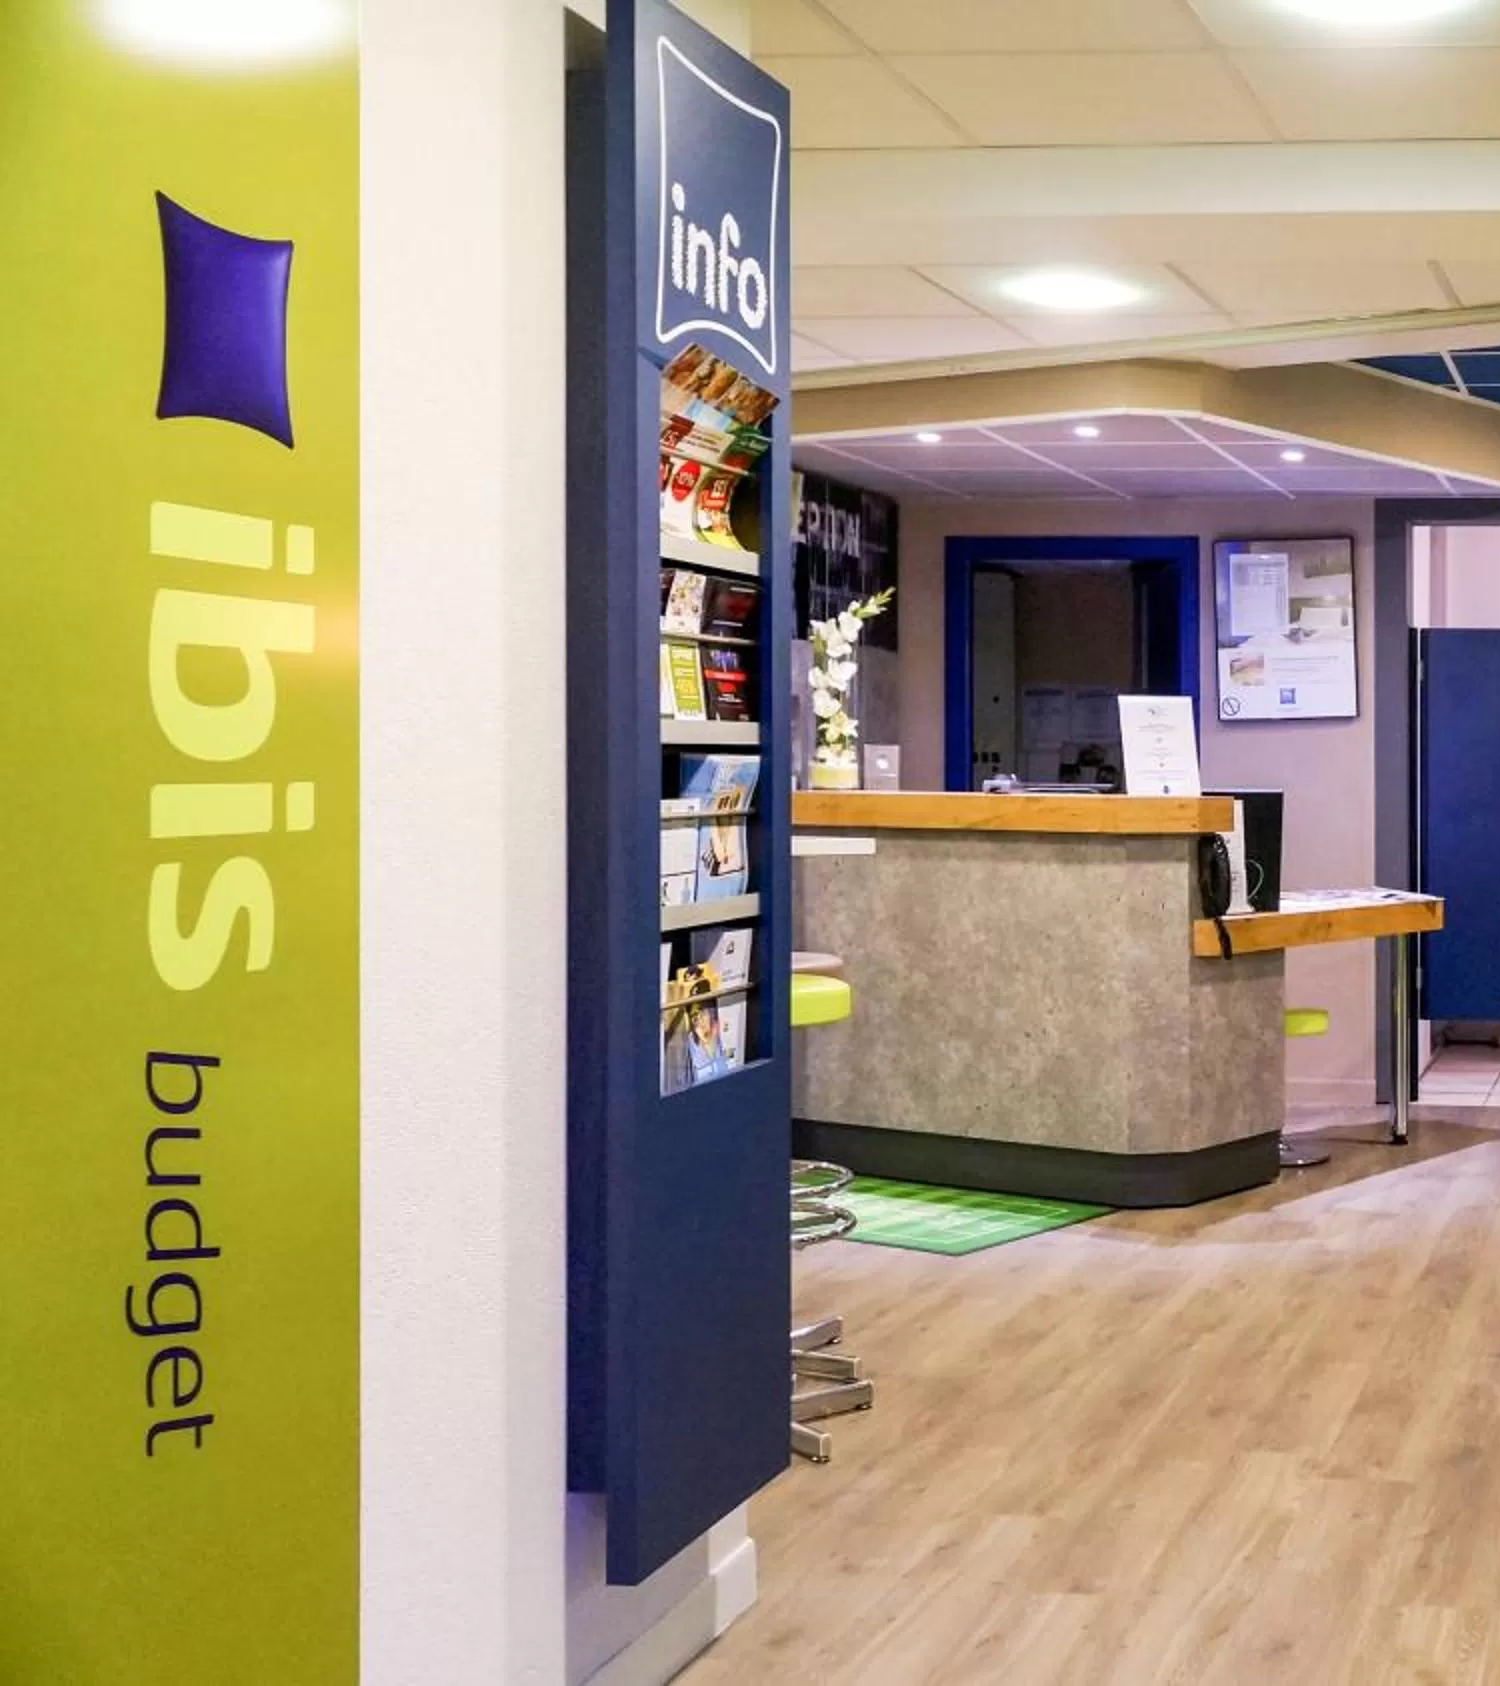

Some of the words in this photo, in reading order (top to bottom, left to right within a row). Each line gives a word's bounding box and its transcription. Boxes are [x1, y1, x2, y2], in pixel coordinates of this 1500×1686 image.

[672, 182, 767, 329] info
[149, 501, 315, 990] ibis
[126, 1051, 221, 1457] budget
